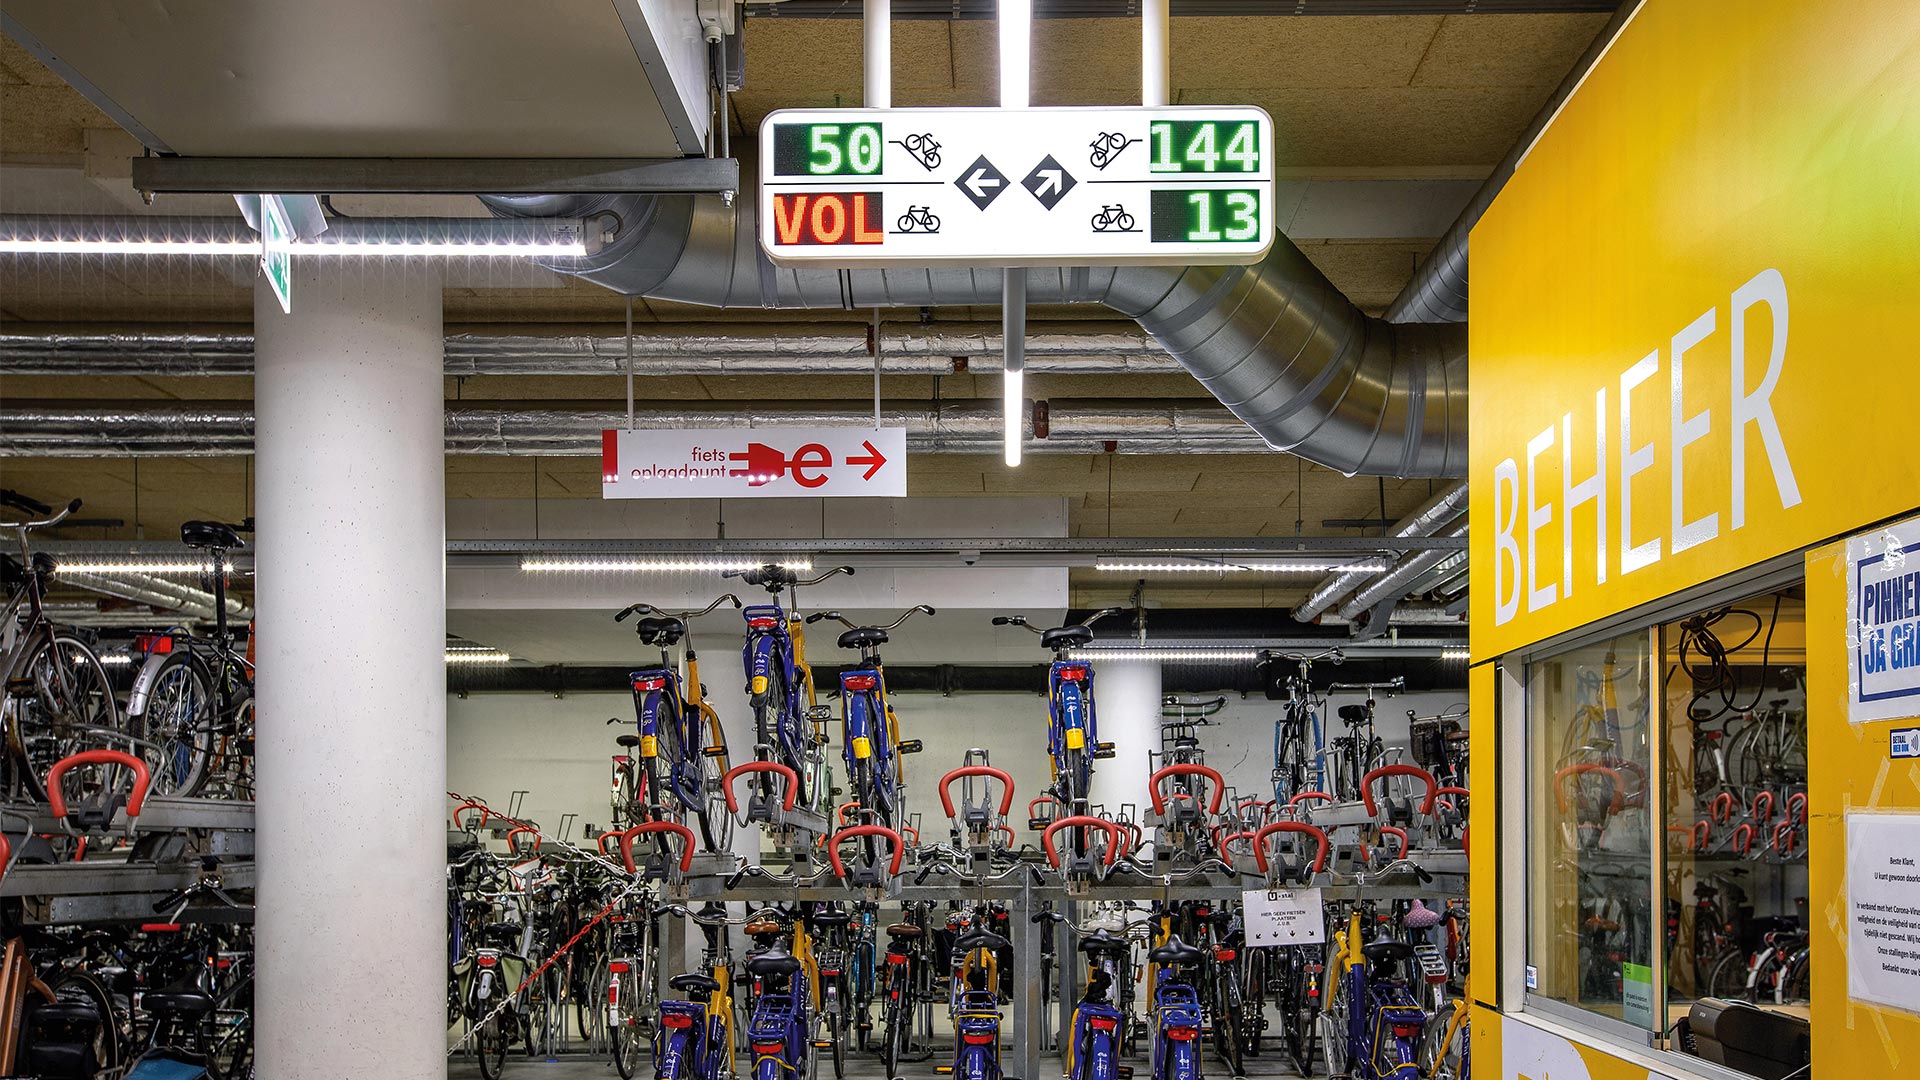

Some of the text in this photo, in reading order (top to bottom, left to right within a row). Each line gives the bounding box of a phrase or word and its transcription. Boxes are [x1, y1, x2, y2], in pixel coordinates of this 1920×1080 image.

[809, 126, 881, 174] 50
[1150, 124, 1259, 172] 144
[774, 195, 883, 243] VOL
[1188, 192, 1258, 241] 13
[691, 446, 726, 461] fiets
[1494, 267, 1802, 627] BEHEER
[631, 463, 726, 481] oplaadpunt
[1864, 628, 1887, 674] JA
